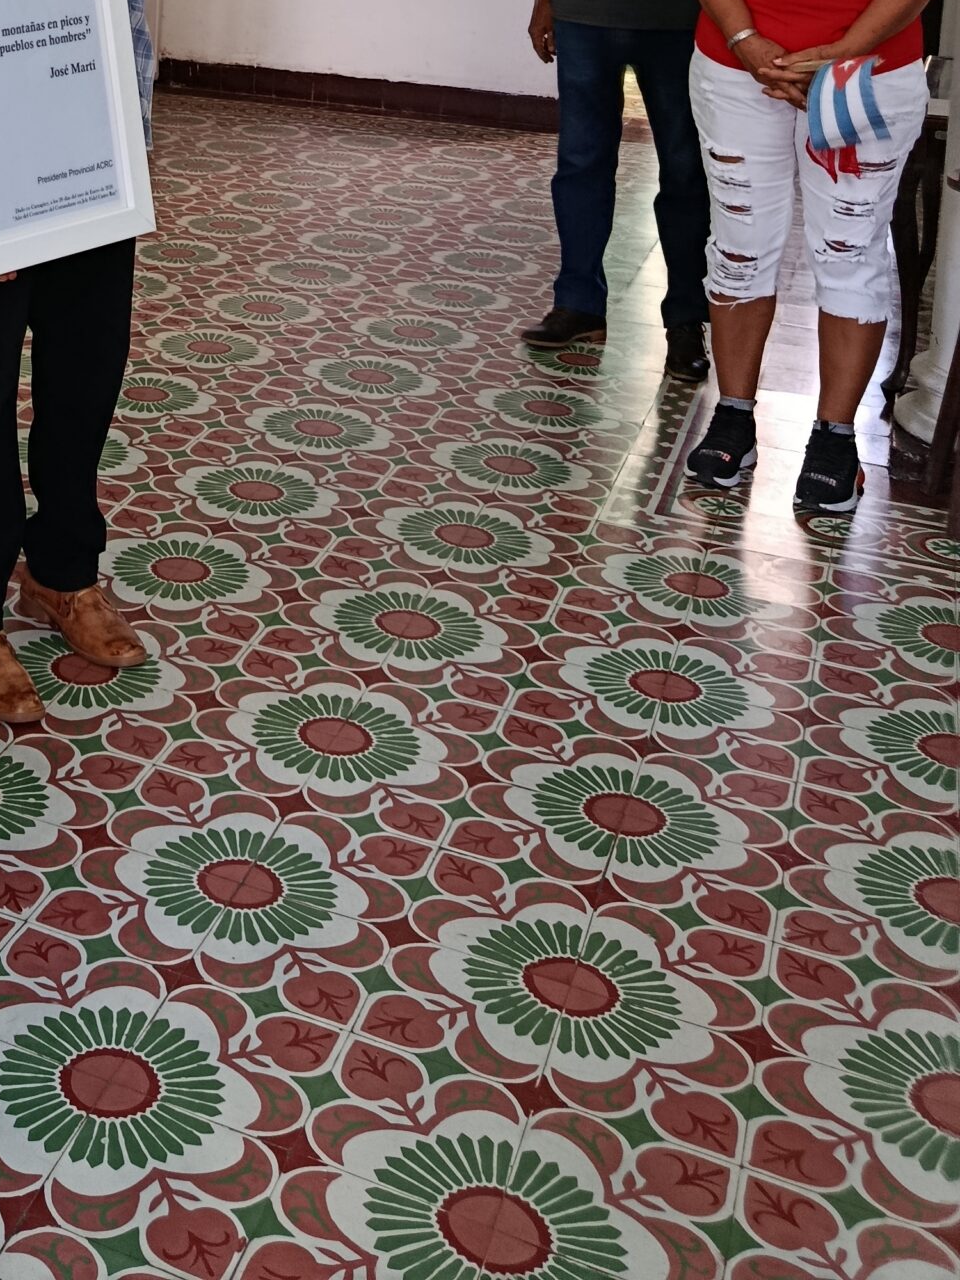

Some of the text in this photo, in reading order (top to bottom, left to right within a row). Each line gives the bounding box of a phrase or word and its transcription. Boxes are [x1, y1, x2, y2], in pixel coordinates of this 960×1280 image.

[2, 22, 46, 37] montañas
[48, 19, 58, 30] en
[60, 15, 83, 30] picos
[84, 14, 90, 25] y
[0, 39, 34, 57] pueblos
[36, 38, 48, 48] en
[50, 64, 69, 78] José
[38, 160, 114, 184] Presidente Provincial ACRC
